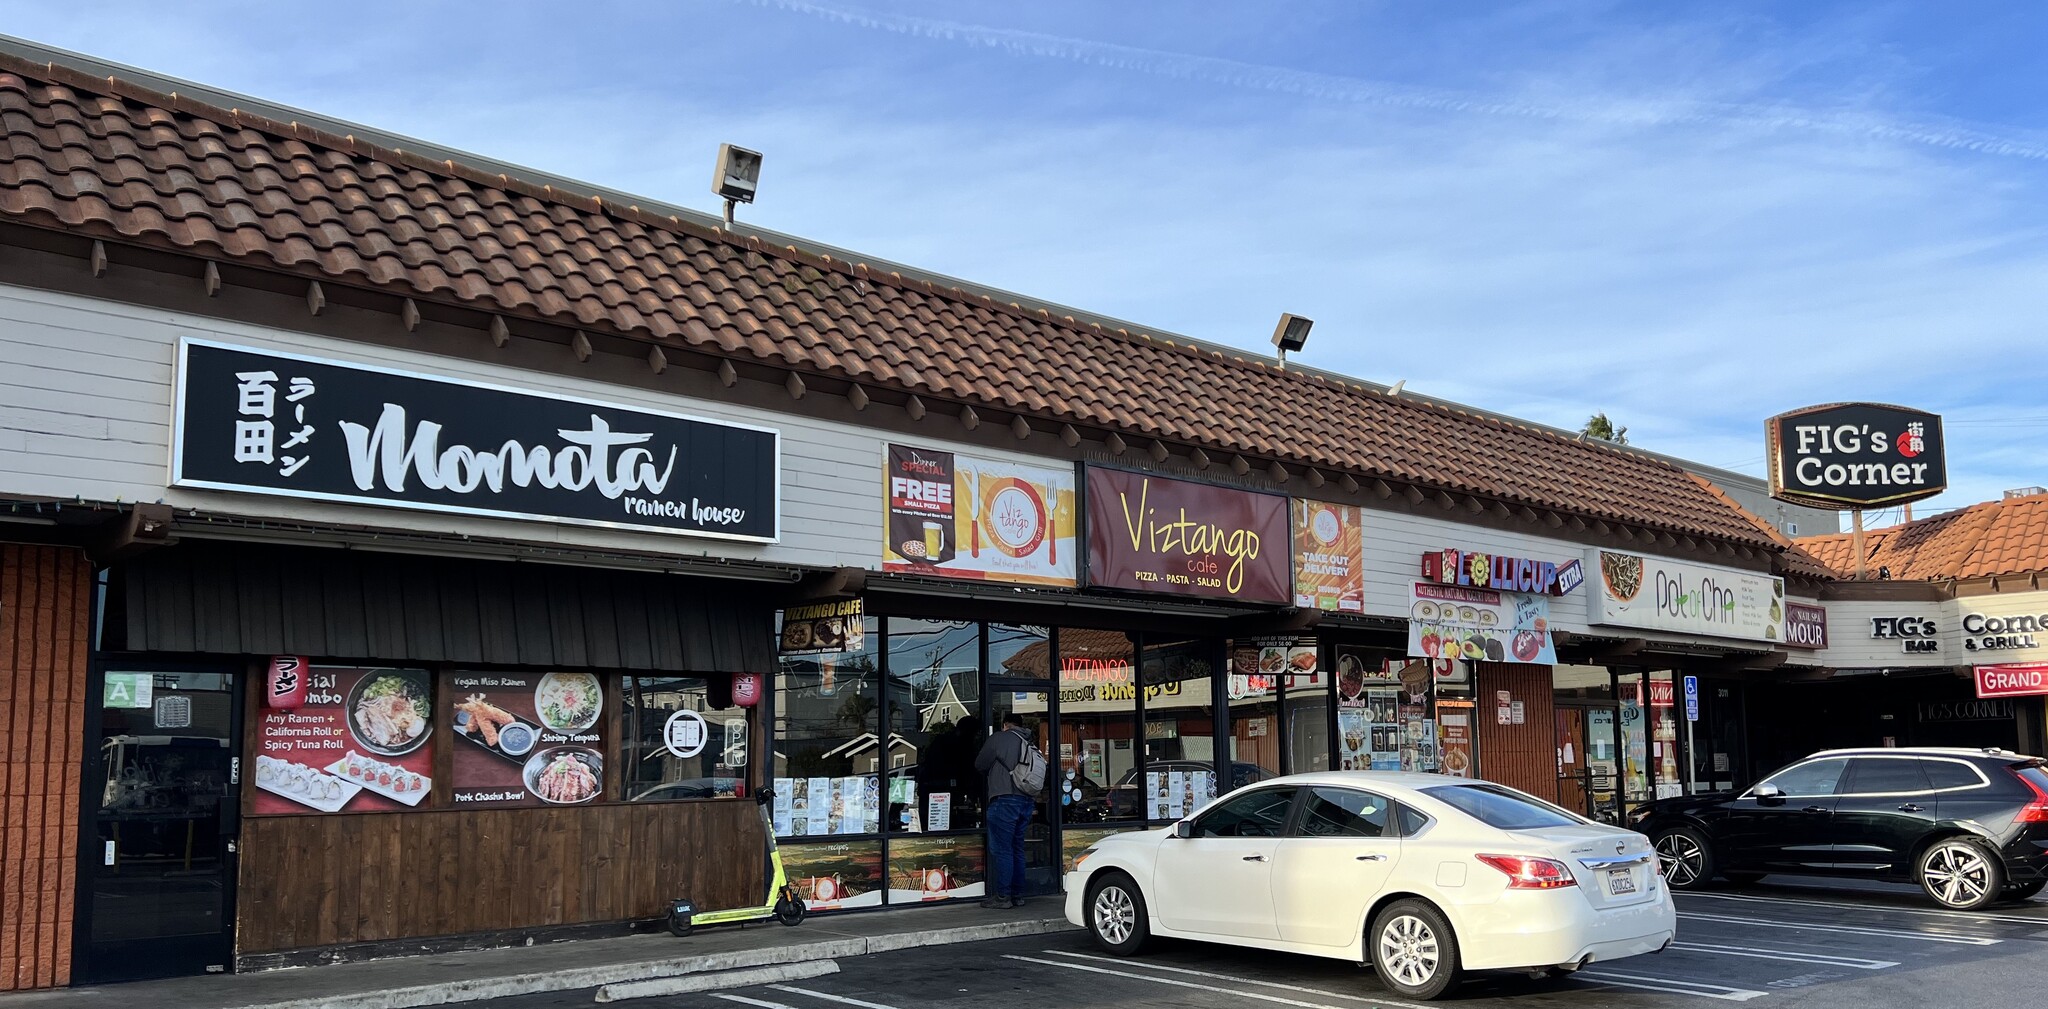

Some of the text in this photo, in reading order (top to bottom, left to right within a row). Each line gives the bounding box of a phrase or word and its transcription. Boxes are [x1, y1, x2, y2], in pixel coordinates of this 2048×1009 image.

[234, 370, 278, 465] 百田
[279, 376, 315, 477] ラーメン
[1796, 424, 1889, 454] FIG's
[339, 402, 677, 499] Momota
[911, 451, 937, 467] Dinner
[901, 461, 946, 476] SPECIAL
[1796, 457, 1928, 486] Corner
[892, 476, 952, 504] FREE
[624, 496, 745, 526] ramen house
[904, 500, 940, 510] SMALL PIZZA
[1003, 496, 1023, 518] Viz
[1000, 512, 1029, 539] tango
[1018, 543, 1034, 556] Salad
[1035, 526, 1043, 542] Grill
[1120, 478, 1260, 594] Viztango
[1187, 555, 1218, 575] cafe
[1303, 552, 1349, 566] TAKE OUT
[1304, 563, 1349, 577] DELIVERY
[1558, 563, 1582, 593] EXTRA
[1135, 571, 1158, 582] PIZZA
[1166, 574, 1190, 585] PASTA
[1197, 577, 1221, 588] SALAD
[1416, 585, 1443, 598] AUTHENTIC
[1444, 589, 1466, 601] NATURAL
[785, 599, 861, 620] VIZTANGO CAFE
[1516, 596, 1533, 612] Fresh
[1797, 611, 1820, 623] NAIL SPA
[1786, 621, 1823, 645] MOUR
[1871, 616, 1937, 638] FIG's
[1904, 640, 1938, 653] BAR
[1965, 635, 2039, 650] & GRILL
[1061, 657, 1128, 682] VIZTANGO
[454, 677, 526, 688] Vegan Miso Ramen
[1984, 671, 2042, 690] GRAND
[109, 682, 130, 700] A
[305, 689, 342, 704] mbo
[265, 714, 286, 725] Any
[288, 714, 325, 723] Ramen
[265, 727, 311, 736] California
[313, 727, 331, 736] Roll
[542, 733, 600, 744] Shrimp Tempura
[265, 740, 344, 751] Spicy Tuna Roll
[455, 791, 525, 802] Pork Chashu Bowl
[892, 784, 903, 798] A
[827, 842, 849, 855] recipes
[936, 838, 955, 848] recipes
